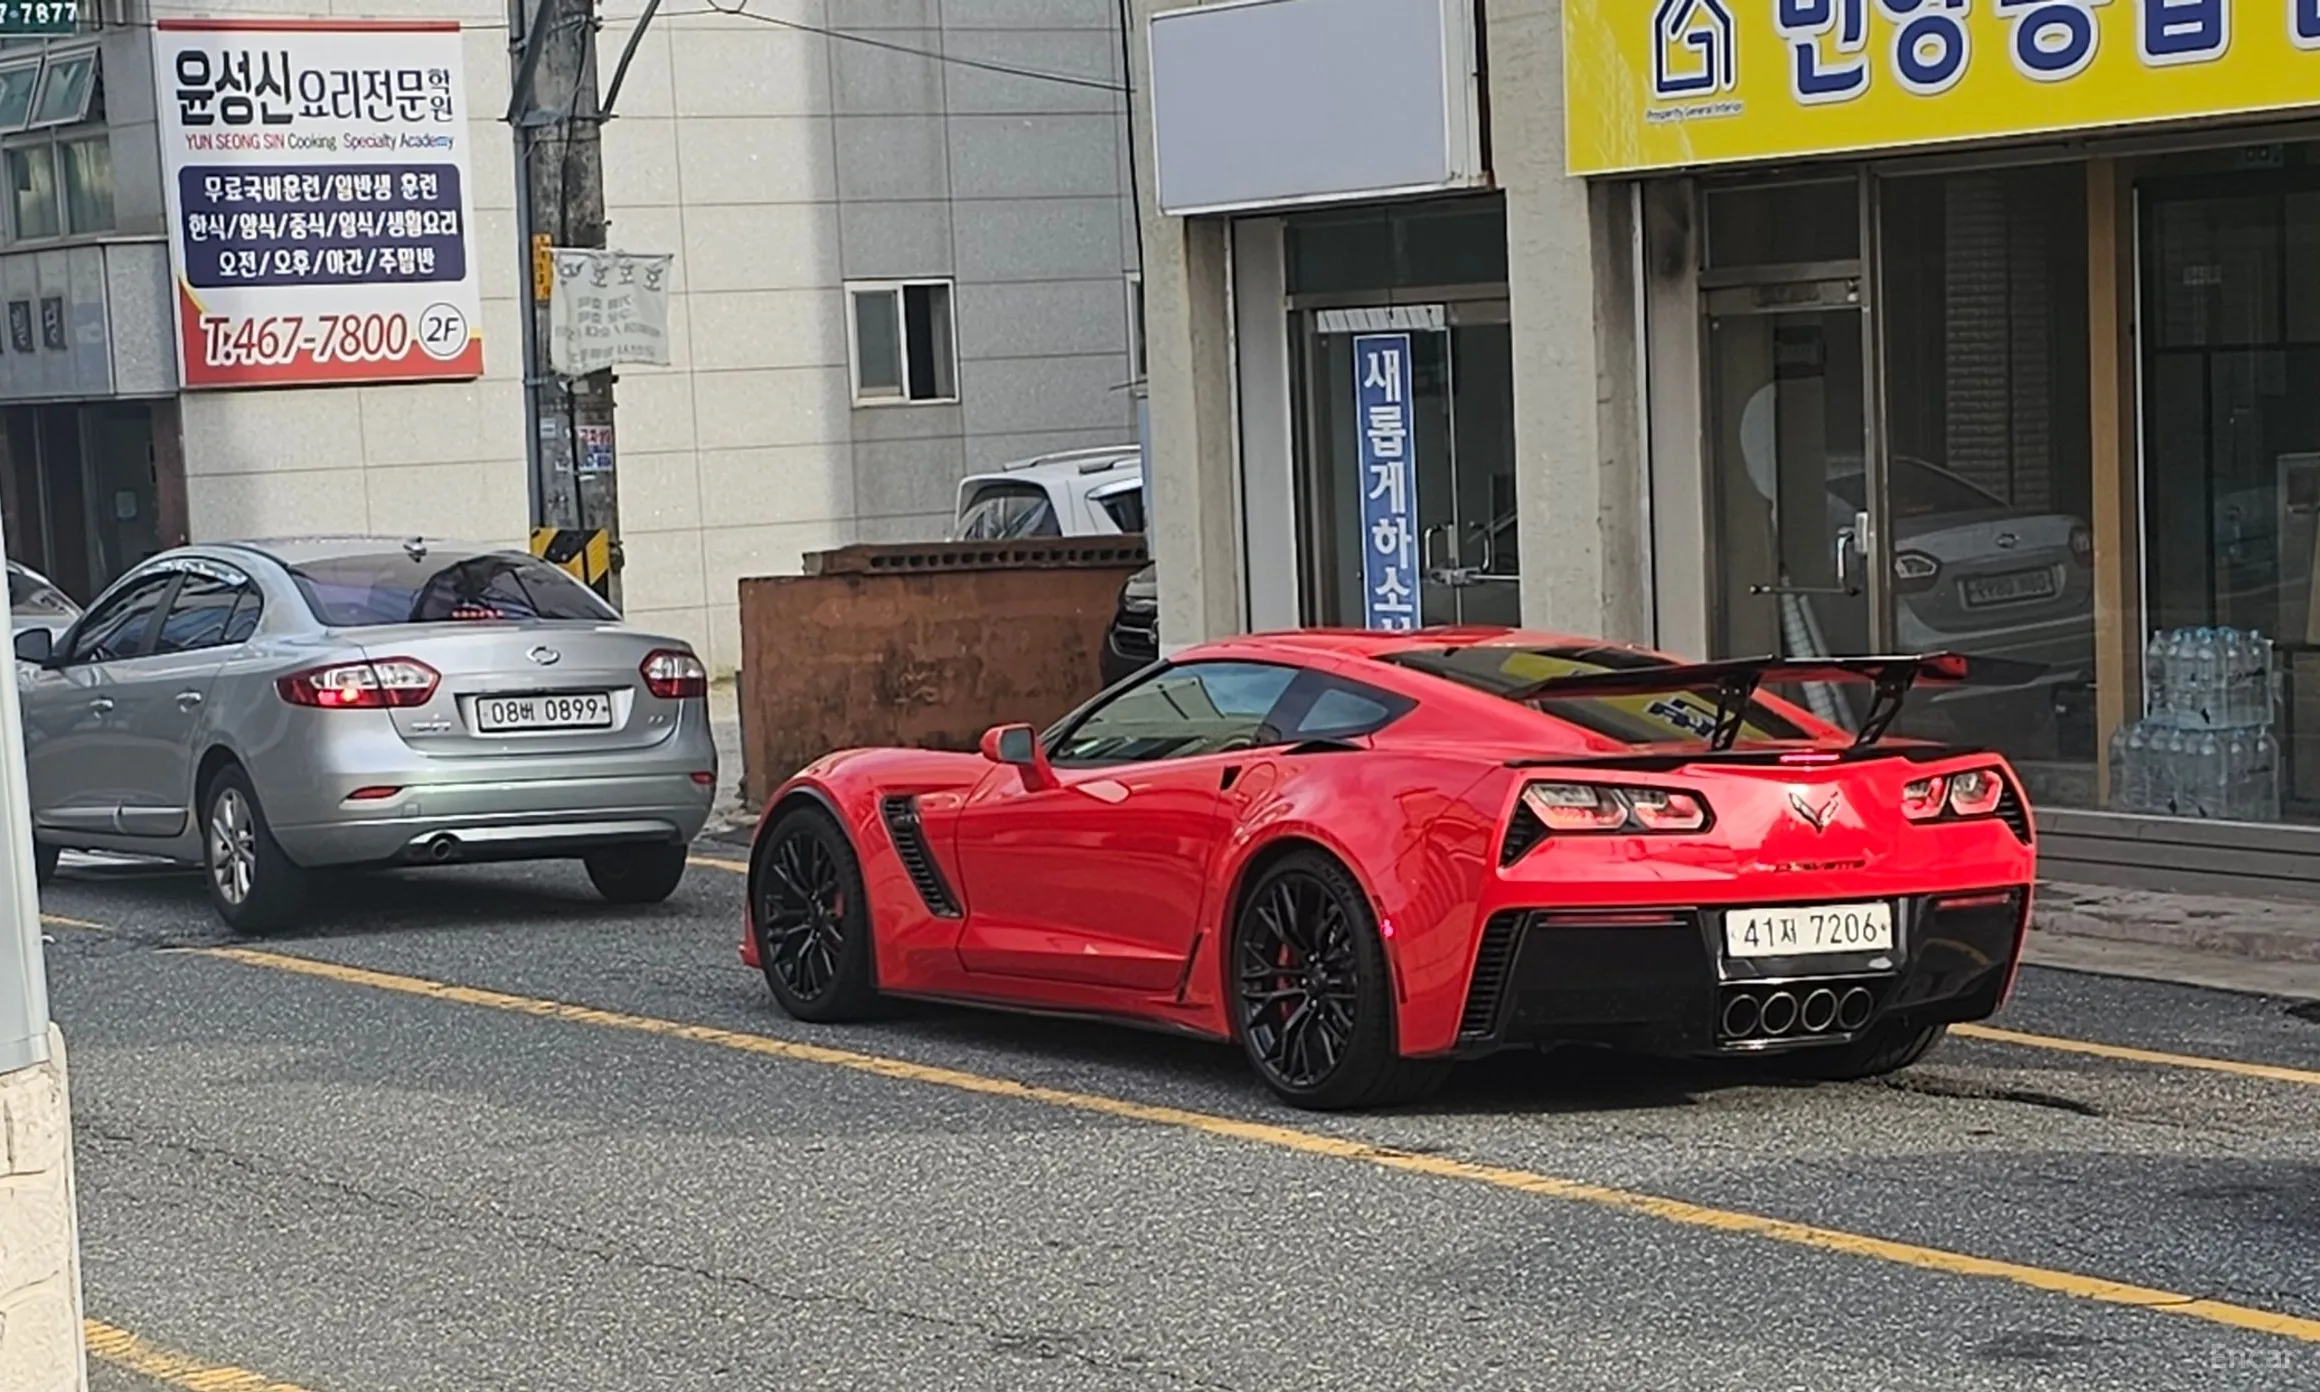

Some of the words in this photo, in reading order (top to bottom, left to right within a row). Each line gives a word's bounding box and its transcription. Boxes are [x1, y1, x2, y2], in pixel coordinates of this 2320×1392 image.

[176, 50, 293, 126] 윤성신
[299, 69, 427, 122] 요리전문
[185, 133, 213, 150] YUN
[215, 133, 260, 150] SEONG
[263, 132, 285, 150] SIN
[287, 132, 337, 152] Cooking
[343, 132, 397, 152] Specialty
[399, 131, 454, 151] Academy
[400, 172, 439, 201] 훈련
[426, 316, 459, 342] 2F
[491, 701, 536, 724] 08버
[544, 698, 599, 721] 0899
[1810, 912, 1878, 944] 7206
